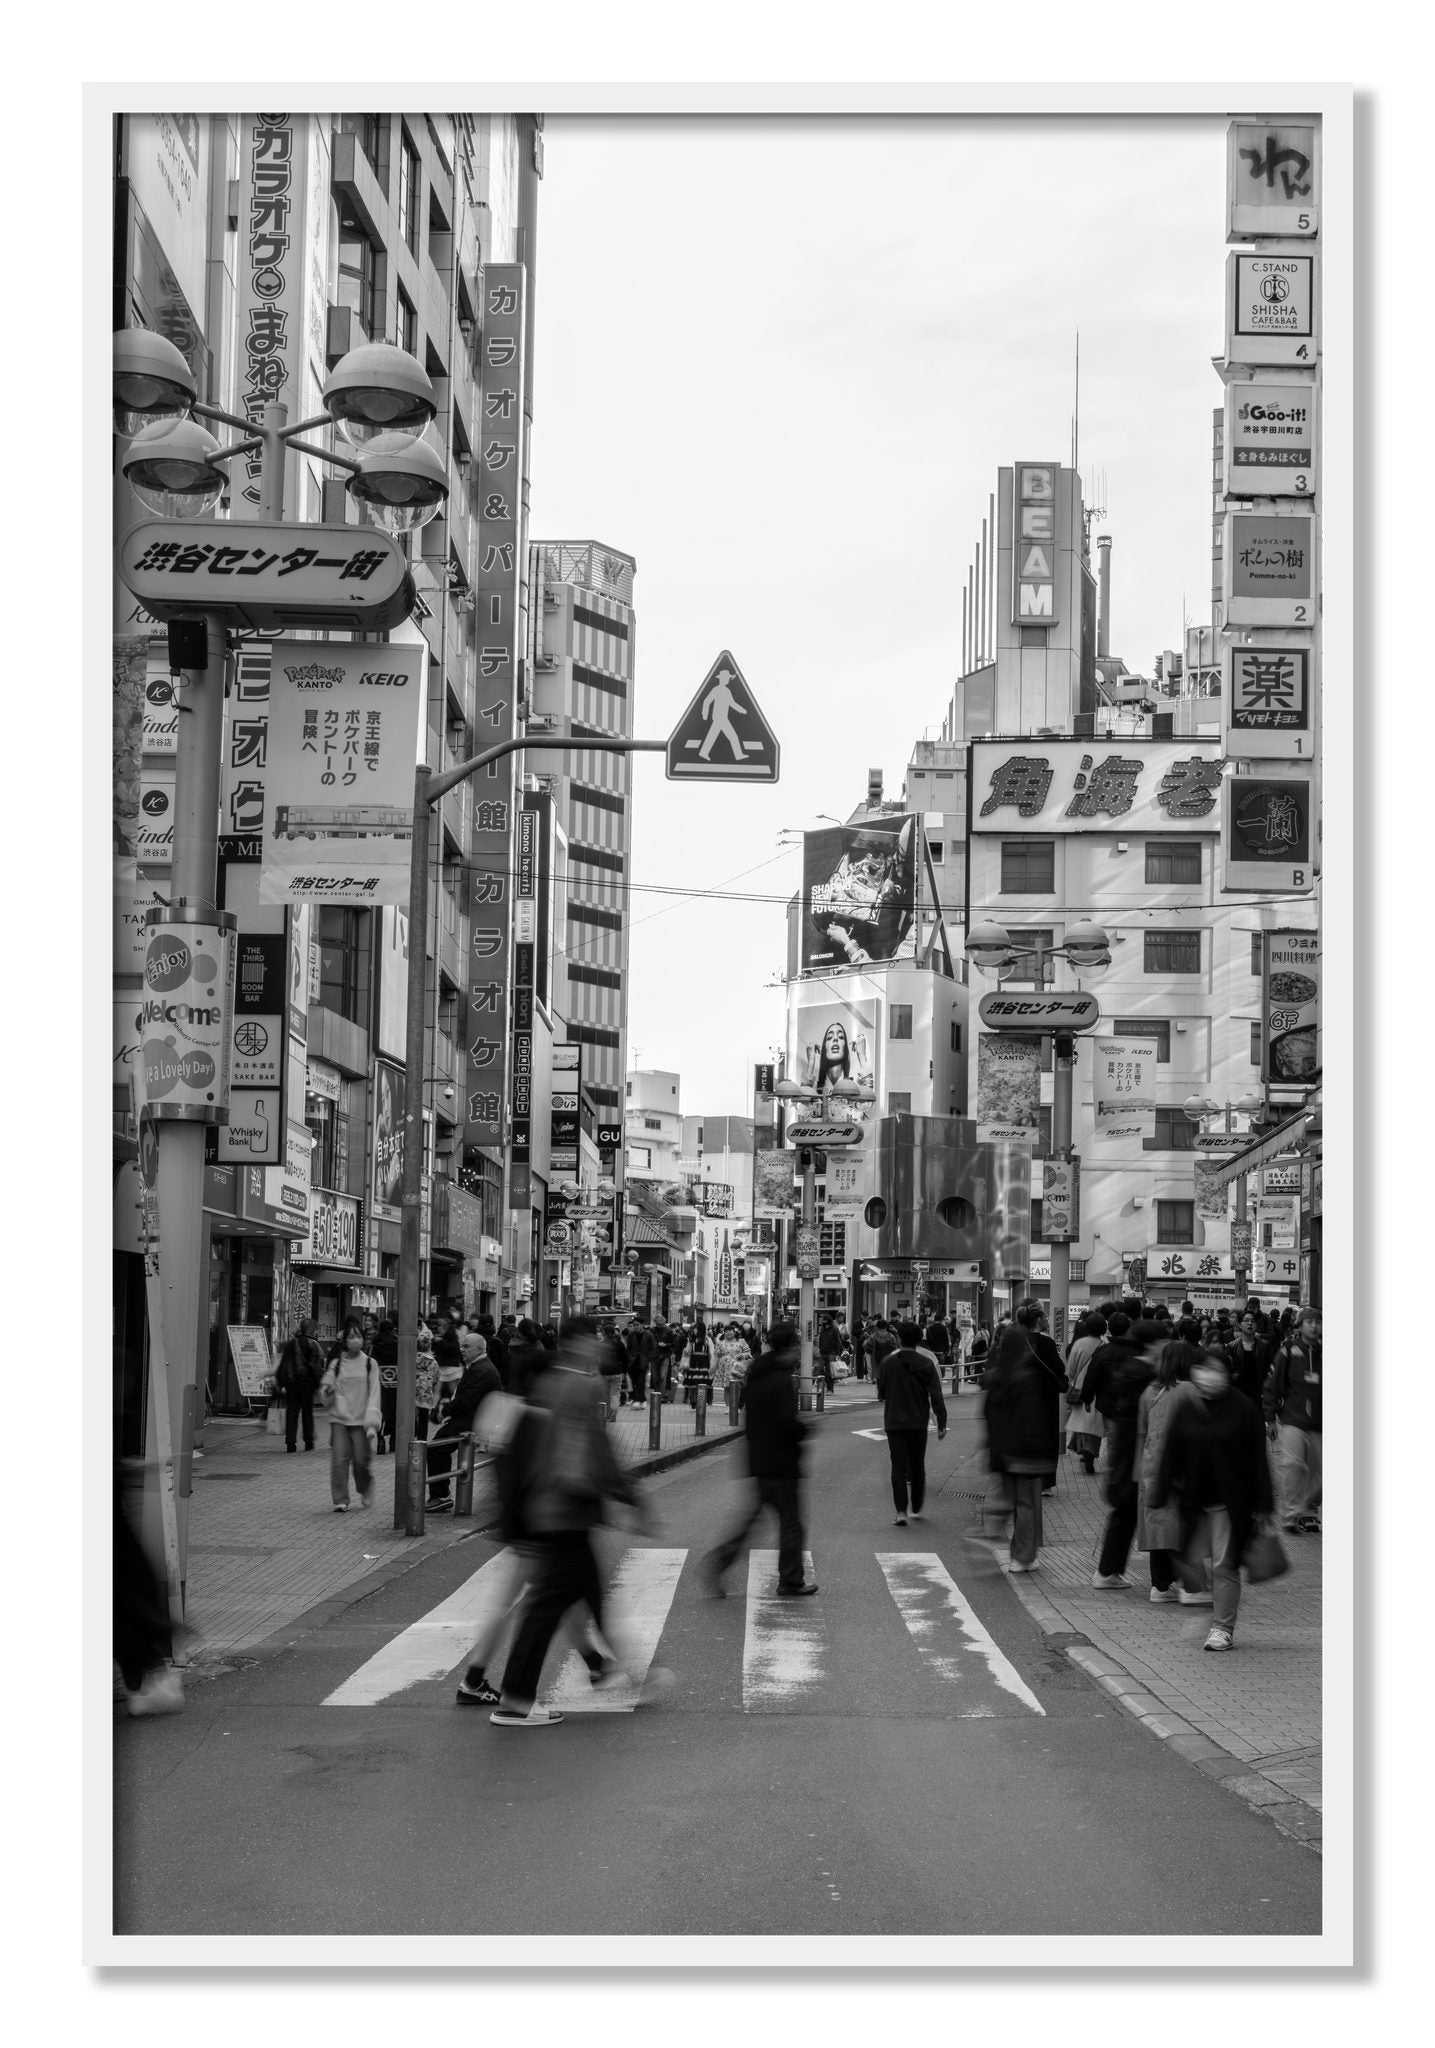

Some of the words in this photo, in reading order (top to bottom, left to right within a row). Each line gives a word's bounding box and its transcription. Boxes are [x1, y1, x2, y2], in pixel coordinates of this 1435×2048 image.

[1239, 135, 1311, 200] わん
[251, 126, 292, 269] カラオケ
[1298, 214, 1310, 230] 5
[1251, 263, 1298, 272] C.STAND
[1251, 305, 1298, 316] SHISHA
[1251, 316, 1297, 325] CAFE&BAR
[1296, 344, 1309, 360] 4
[1250, 405, 1306, 421] Goo-it!
[1243, 425, 1303, 435] 渋谷宇田川町店
[1238, 452, 1308, 463] 全身もみほぐし
[1295, 474, 1308, 492] 3
[1021, 468, 1052, 616] BEAM
[133, 542, 390, 580] 渋谷センター街
[477, 285, 518, 832] カラオケ&パーティー館
[1238, 547, 1305, 569] ポムの樹
[1249, 572, 1296, 580] Pomme-no-ki
[1294, 605, 1307, 622] 2
[297, 681, 333, 689] KANTO
[359, 673, 409, 687] KEIO
[1242, 656, 1294, 708] 薬
[1236, 711, 1300, 726] マツモトキヨシ
[301, 709, 319, 754] 冒険へ
[147, 738, 172, 747] 渋谷店
[320, 709, 339, 786] カントーの
[341, 709, 360, 787] ポケパーク
[363, 710, 382, 772] 京王線で
[1293, 737, 1303, 754] 1
[979, 755, 1223, 817] 角海老
[1236, 795, 1299, 845] 一蘭
[522, 816, 531, 853] kimono
[142, 848, 168, 857] 渋谷店
[289, 877, 381, 890] 渋谷センター街
[521, 858, 530, 894] hearts
[1293, 869, 1305, 886] B
[811, 883, 852, 895] SHAPING
[147, 948, 188, 985] Enjoy
[242, 954, 265, 962] THIRD
[468, 873, 505, 1125] カラオケ館
[143, 1000, 222, 1026] Welcome
[986, 1001, 1092, 1015] 渋谷センター街
[1270, 1011, 1299, 1031] 6F
[160, 1060, 192, 1081] Lovely
[193, 1061, 214, 1076] Day!
[229, 1127, 264, 1139] Whisky
[600, 1131, 620, 1142] GU
[790, 1128, 854, 1137] 渋谷センター街
[989, 1130, 1027, 1138] 渋谷センター街
[228, 1137, 250, 1146] Bank
[721, 1252, 730, 1295] BEER
[1161, 1254, 1222, 1276] 兆楽
